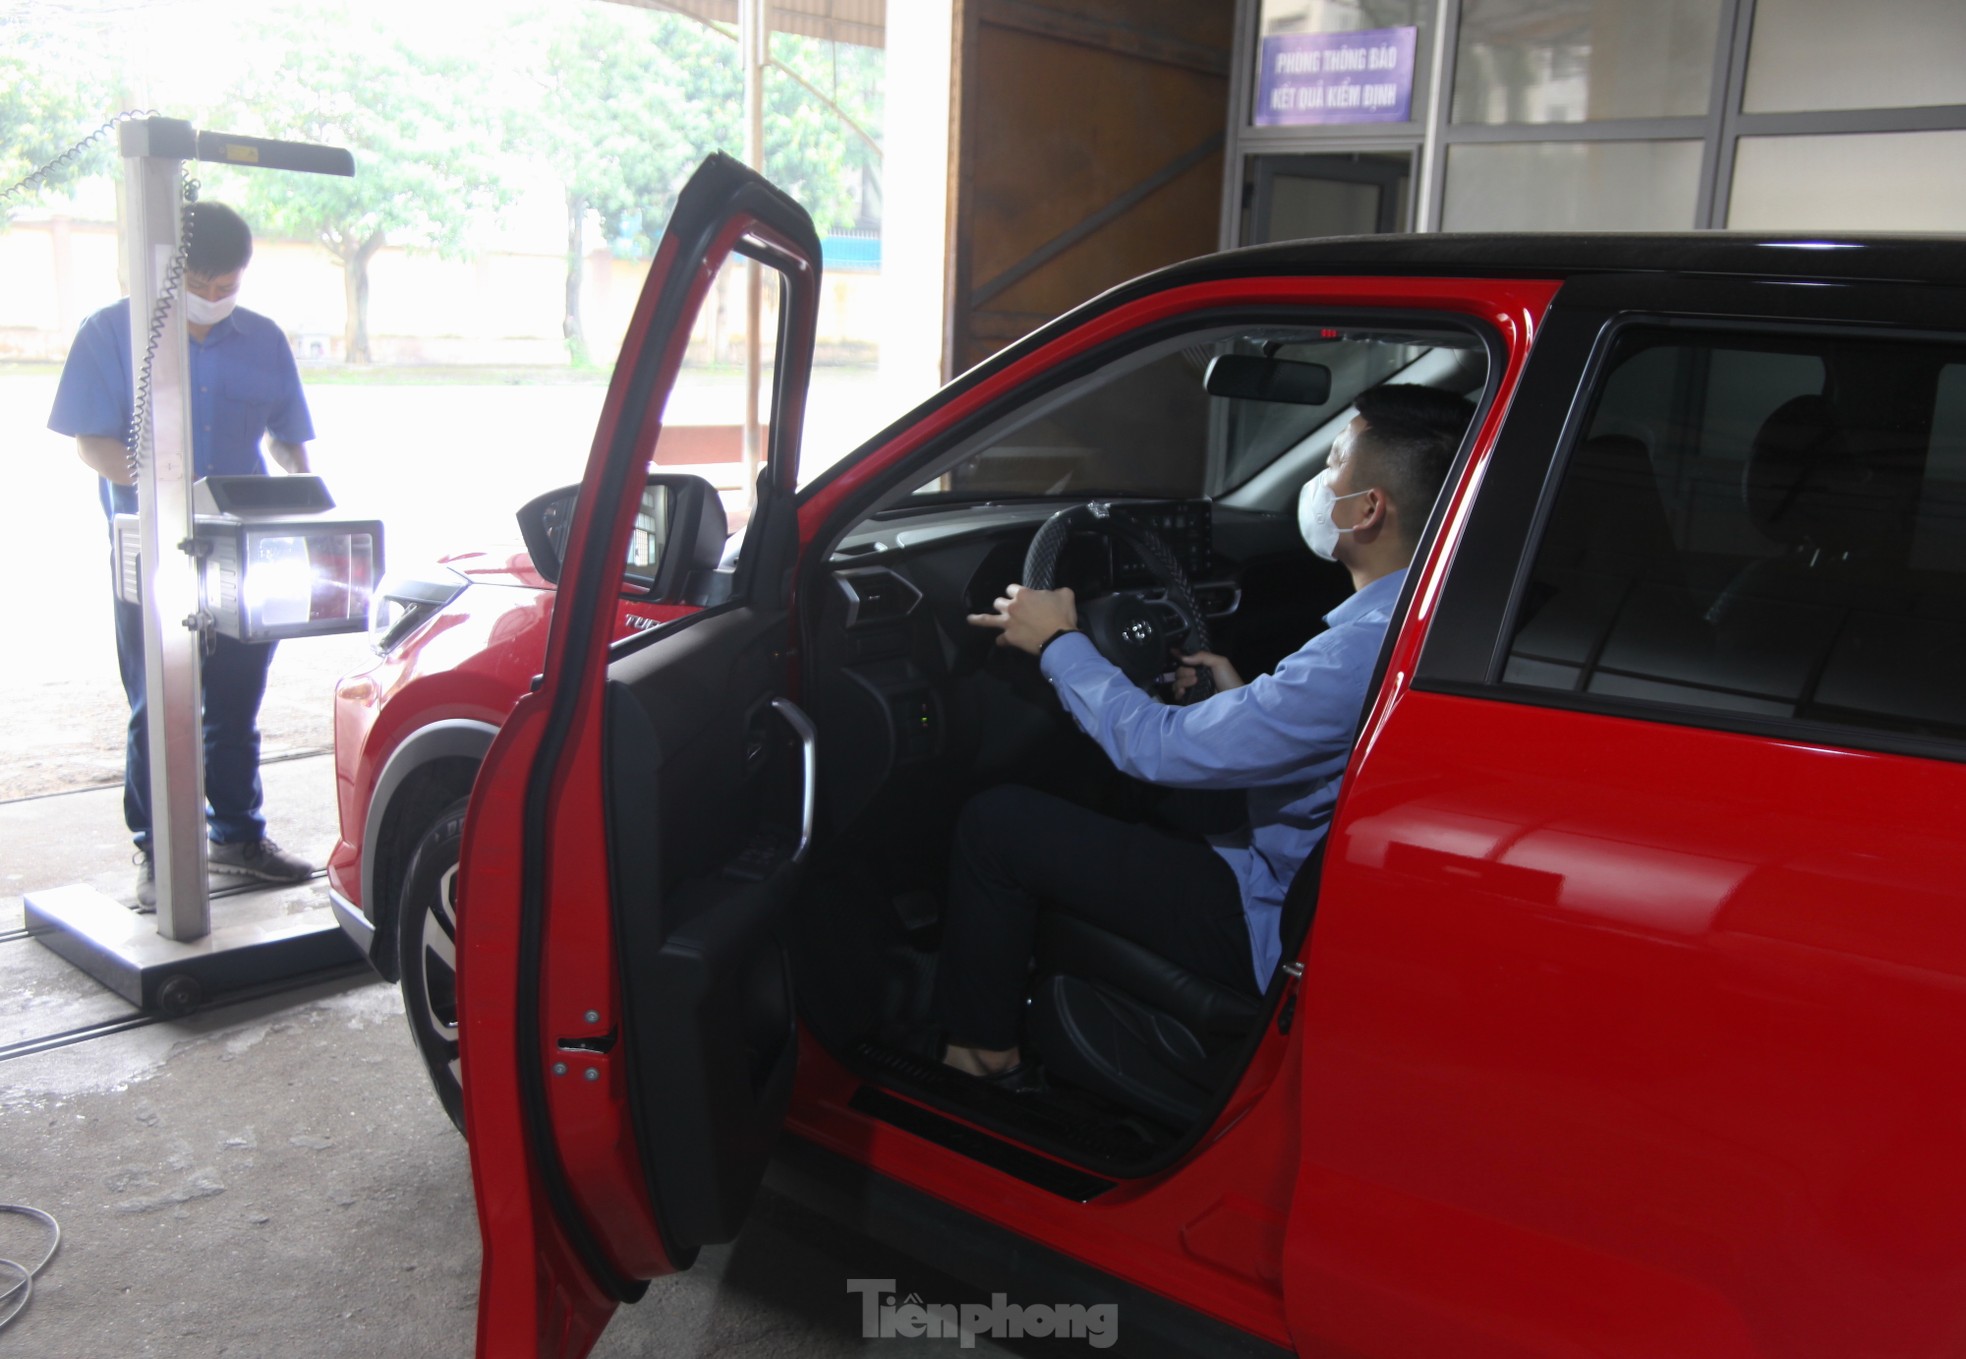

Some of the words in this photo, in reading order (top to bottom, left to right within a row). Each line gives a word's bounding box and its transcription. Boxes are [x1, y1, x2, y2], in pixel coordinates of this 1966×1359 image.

[1275, 47, 1320, 73] PHÒNG
[1323, 44, 1367, 71] THÔNG
[1368, 42, 1398, 69] BÁO
[1270, 80, 1296, 111] KẾT
[1297, 80, 1324, 111] QUẢ
[1325, 77, 1361, 109] KIỂM
[1362, 83, 1398, 112] ĐỊNH
